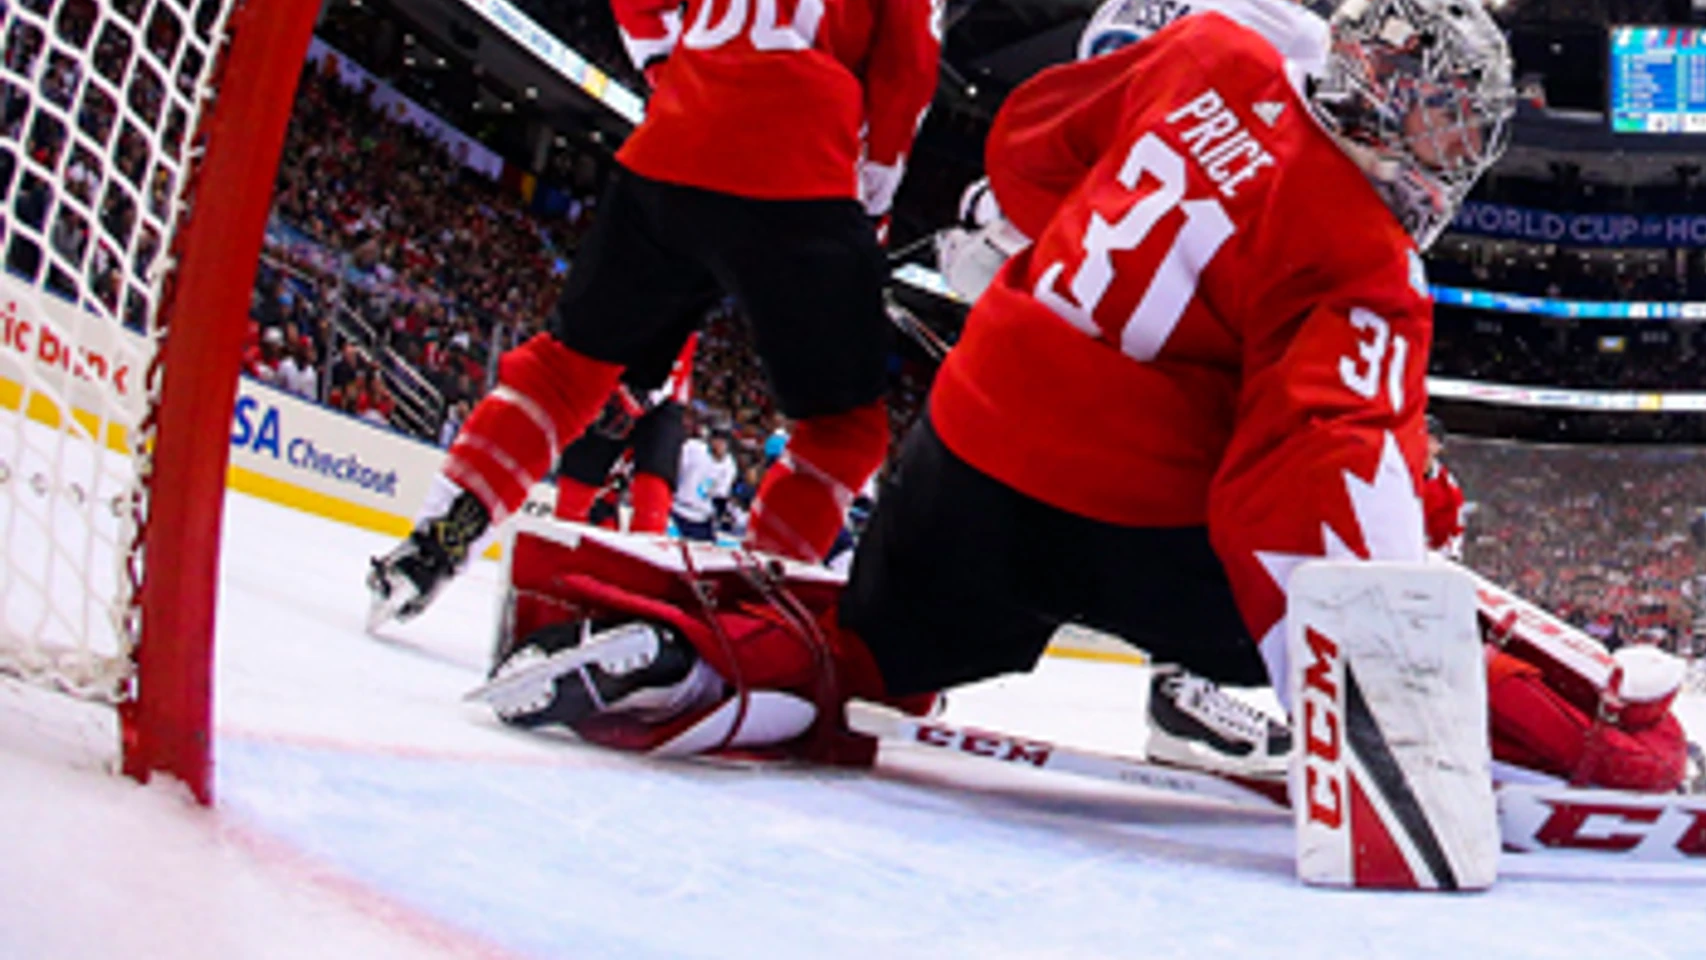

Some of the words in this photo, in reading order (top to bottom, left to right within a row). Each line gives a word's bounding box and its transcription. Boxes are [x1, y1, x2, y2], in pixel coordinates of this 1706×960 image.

[1165, 88, 1277, 198] PRICE
[1033, 132, 1236, 362] 31
[1455, 203, 1566, 240] WORLD
[1569, 213, 1639, 242] CUP
[1339, 306, 1408, 413] 31
[286, 437, 398, 498] Checkout
[914, 723, 1056, 767] CCM
[1303, 623, 1344, 831] CCM
